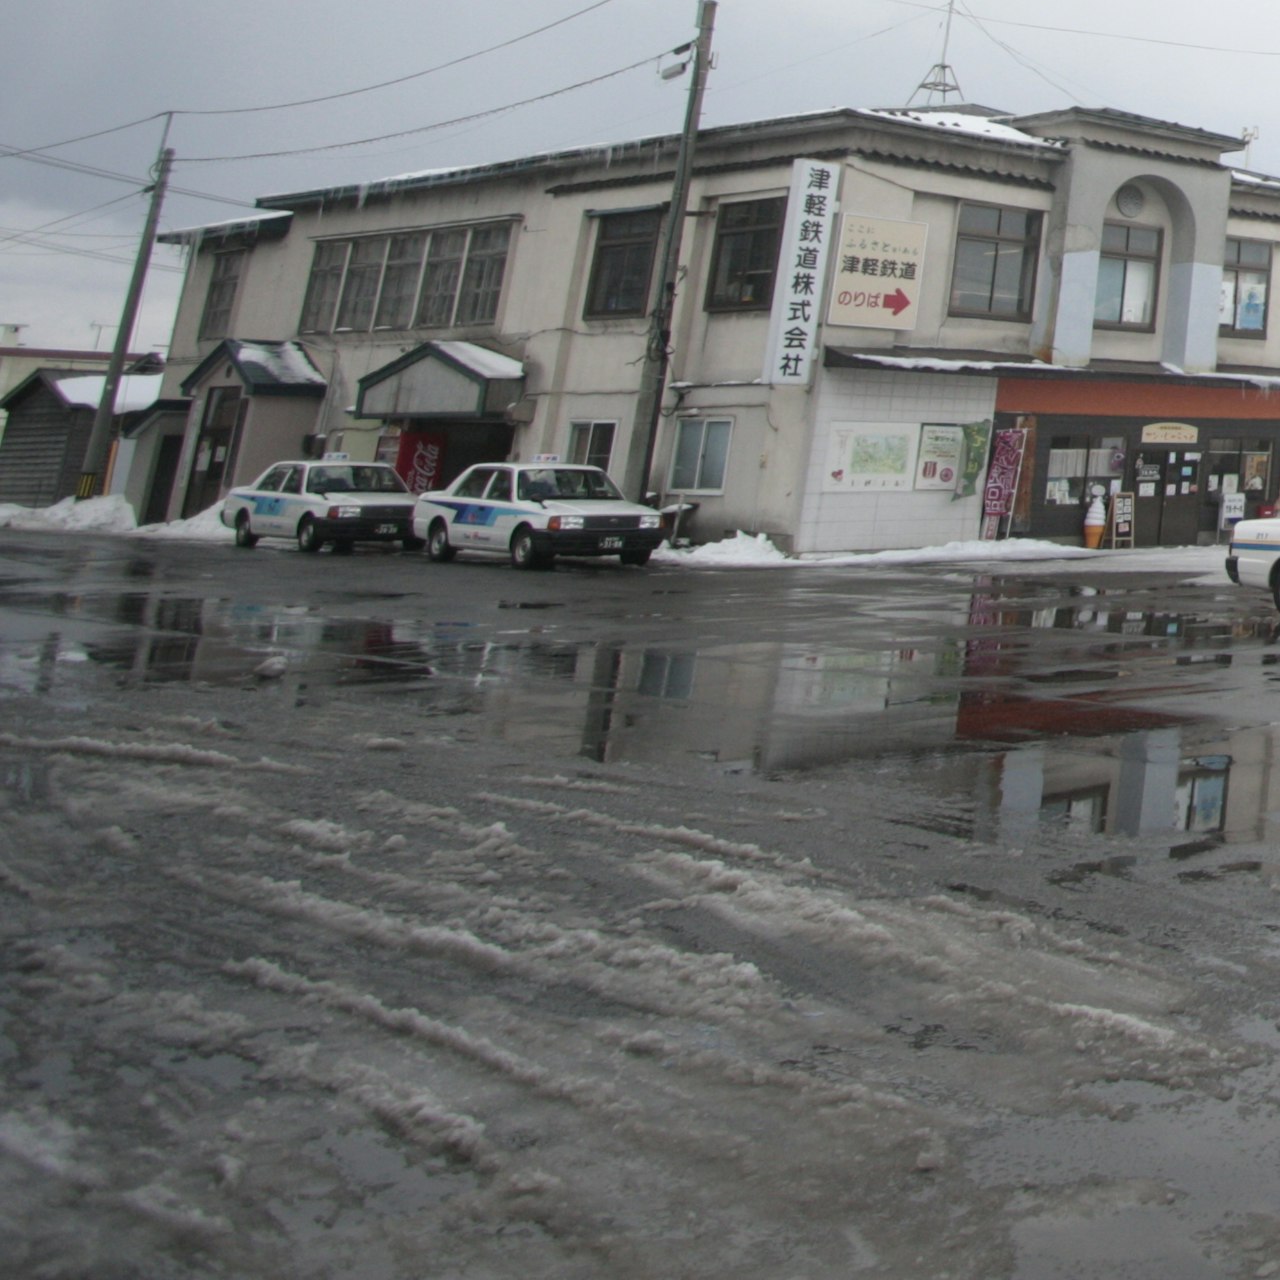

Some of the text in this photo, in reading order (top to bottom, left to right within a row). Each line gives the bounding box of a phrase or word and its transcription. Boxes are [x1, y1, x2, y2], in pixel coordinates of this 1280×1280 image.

[779, 167, 831, 377] 津軽鉄道株式会社
[840, 255, 917, 280] 津軽鉄道
[837, 290, 880, 308] のりば
